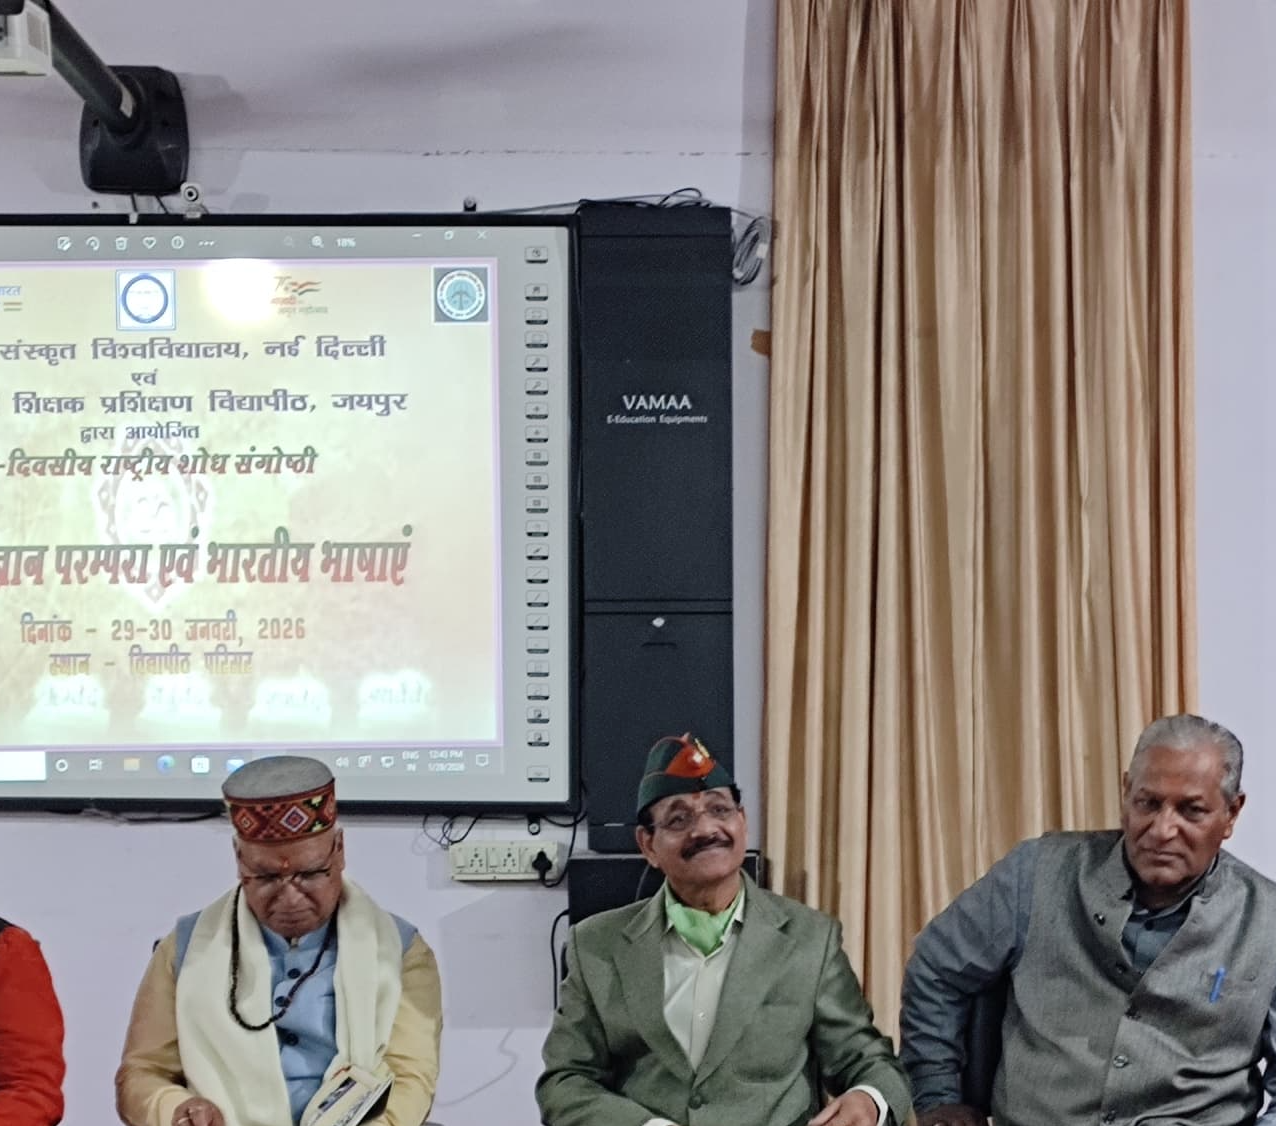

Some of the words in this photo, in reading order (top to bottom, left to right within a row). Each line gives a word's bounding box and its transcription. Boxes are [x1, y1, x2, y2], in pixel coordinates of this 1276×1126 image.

[91, 337, 249, 362] विश्वविद्यालय,
[263, 335, 304, 358] नई
[315, 335, 386, 360] दिल्ली
[130, 370, 158, 387] एवं
[13, 392, 84, 415] शिक्षक
[100, 390, 192, 416] प्रशिक्षण
[209, 389, 316, 415] विद्यापीठ,
[331, 393, 408, 417] जयपुर
[622, 394, 692, 411] VAMAA
[80, 425, 115, 442] द्वारा
[126, 421, 199, 440] आयोजित
[606, 414, 656, 424] E-Education
[659, 414, 708, 425] Equipments
[100, 448, 170, 481] राष्ट्रीय
[177, 446, 229, 476] शोध
[235, 445, 318, 475] संगोष्ठी
[55, 542, 152, 587] परम्परा
[159, 526, 200, 588] एवं
[207, 526, 314, 585] भारतीय
[320, 524, 413, 587] भाषाएं
[20, 612, 73, 644] दिनांक
[111, 618, 172, 641] 29-30
[257, 617, 306, 641] 2026
